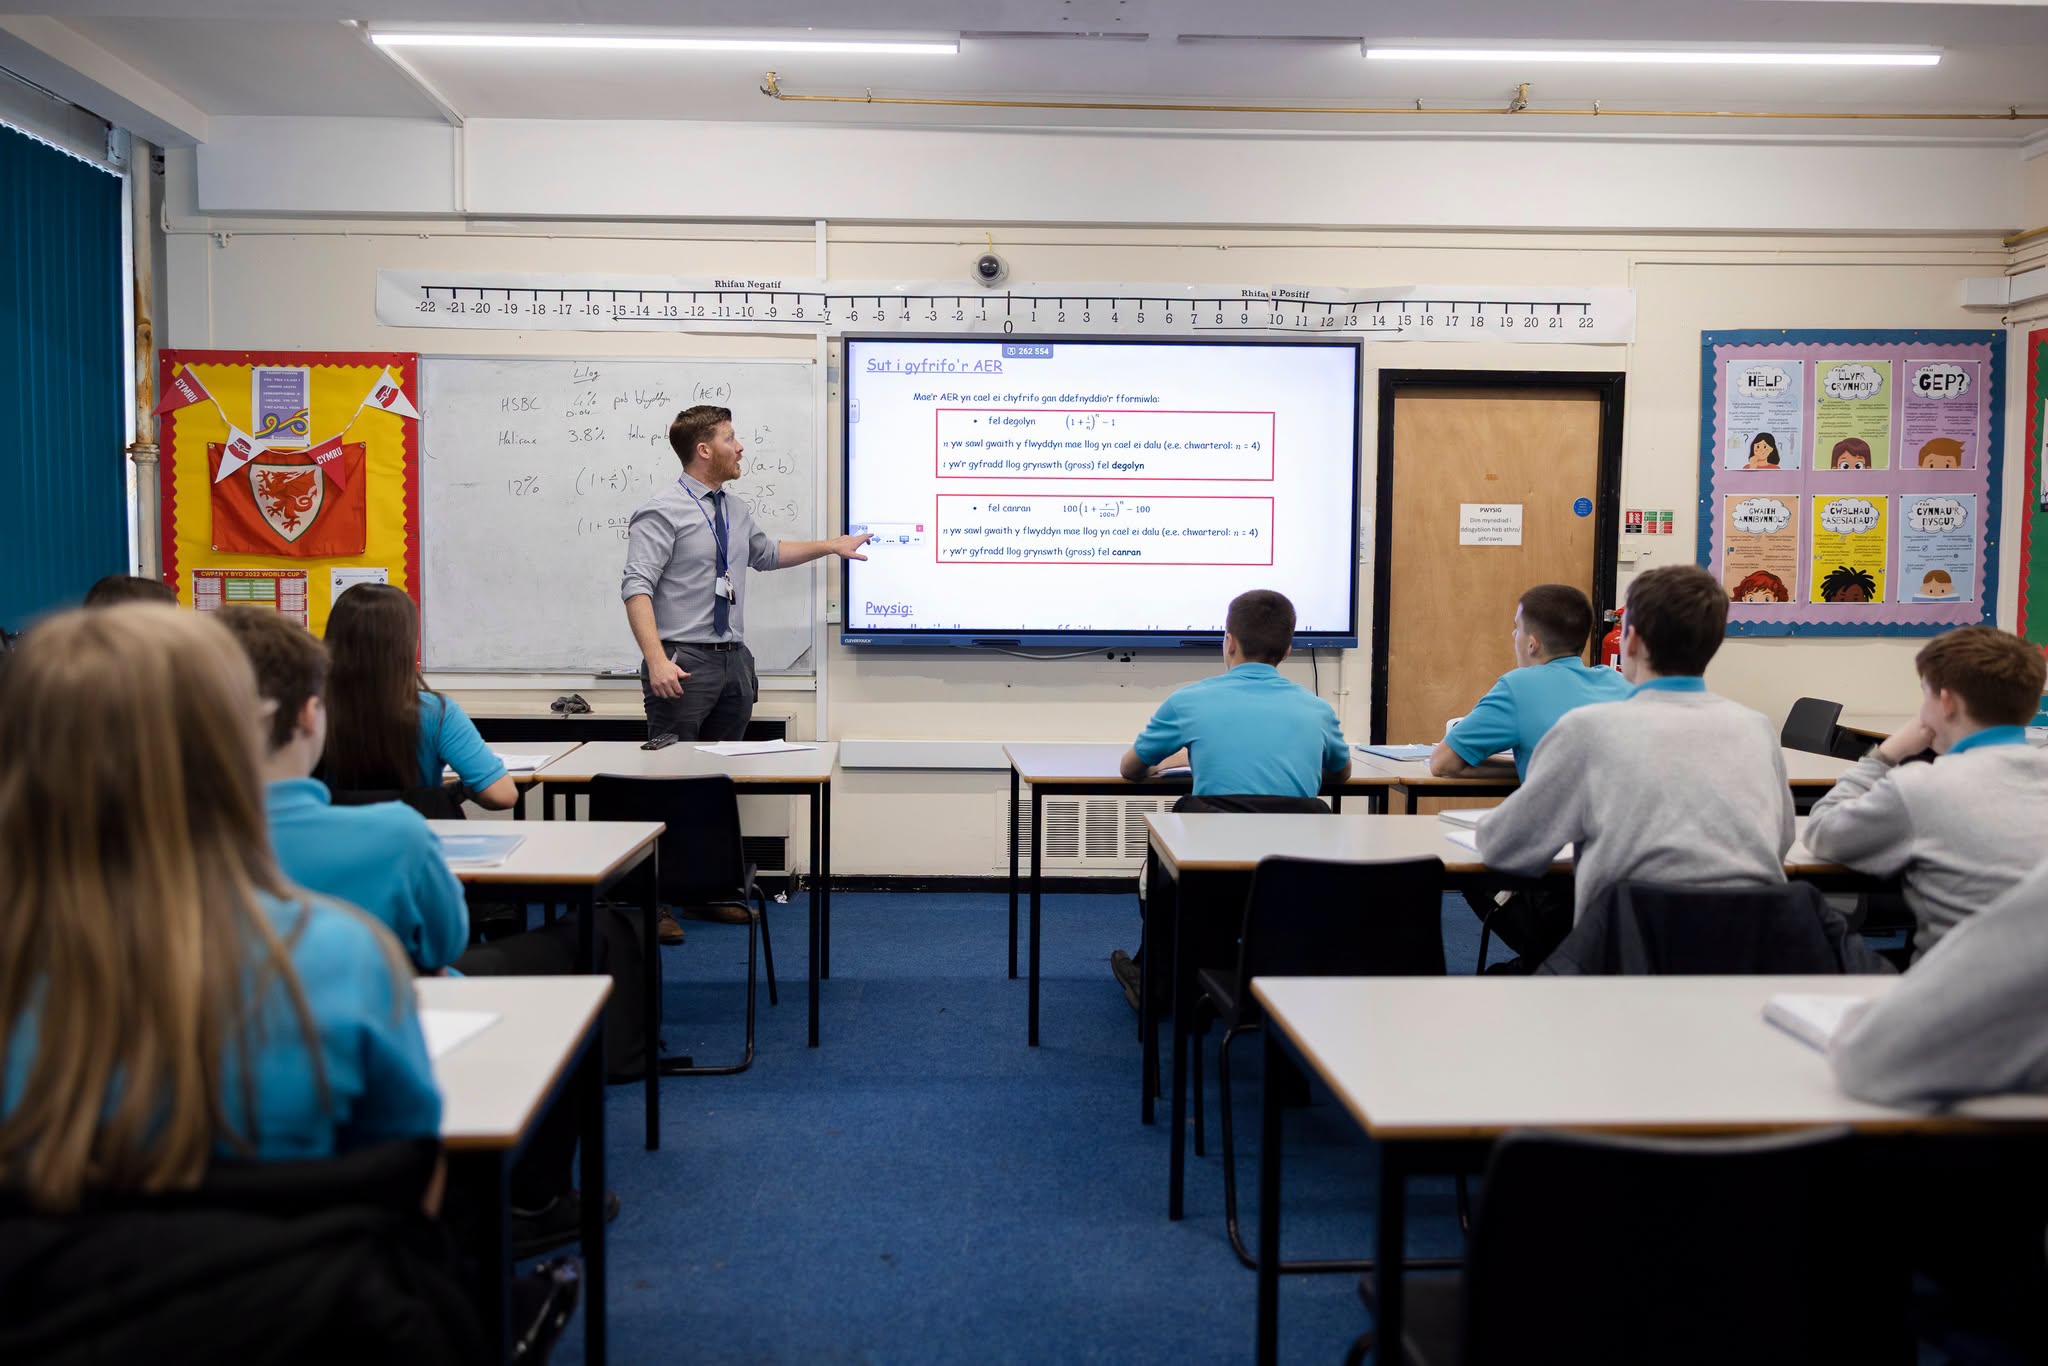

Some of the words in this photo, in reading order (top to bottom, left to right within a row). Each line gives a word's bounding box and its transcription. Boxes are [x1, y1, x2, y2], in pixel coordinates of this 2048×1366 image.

[714, 280, 746, 288] Rhifau
[747, 280, 781, 290] Negatif
[1279, 290, 1309, 298] Positif
[415, 302, 435, 312] -22
[447, 302, 465, 313] -21
[470, 303, 490, 313] -20
[497, 304, 518, 314] -19
[525, 304, 546, 315] -18
[553, 304, 572, 315] -17
[579, 304, 600, 315] -16
[606, 305, 626, 316] -15
[630, 305, 650, 316] -14
[657, 306, 677, 316] -13
[684, 306, 704, 317] -12
[712, 307, 730, 317] -11
[735, 307, 754, 317] -10
[765, 307, 777, 317] -9
[791, 308, 804, 318] -8
[818, 309, 831, 320] -7
[846, 310, 858, 322] -6
[872, 311, 885, 322] -5
[899, 311, 910, 322] -4
[925, 311, 937, 322] -3
[951, 311, 964, 322] -2
[976, 311, 987, 322] -1
[1004, 321, 1013, 334] 0
[1031, 312, 1036, 322] 1
[1058, 312, 1065, 322] 2
[1083, 312, 1090, 322] 3
[1111, 313, 1118, 323] 4
[1137, 313, 1144, 323] 5
[1166, 313, 1173, 323] 6
[1191, 313, 1198, 324] 7
[1216, 313, 1223, 324] 8
[1241, 313, 1248, 324] 9
[1269, 314, 1283, 325] 10
[1295, 315, 1308, 326] 11
[1320, 317, 1334, 327] 12
[1344, 315, 1357, 326] 13
[1372, 315, 1386, 326] 14
[1398, 315, 1411, 326] 15
[1420, 315, 1434, 326] 16
[1446, 315, 1459, 326] 17
[1470, 316, 1484, 327] 18
[1500, 317, 1514, 327] 19
[1524, 317, 1539, 328] 20
[1549, 317, 1563, 328] 21
[1578, 317, 1594, 328] 22
[867, 358, 892, 371] Sut
[896, 359, 900, 371] i
[904, 358, 969, 375] gyfrifo'r
[974, 360, 1003, 372] AER
[1748, 375, 1783, 387] HELP
[1919, 374, 1965, 390] GEP?
[175, 378, 198, 403] CYMRU
[913, 392, 938, 401] Mae'r
[940, 393, 958, 401] AER
[961, 395, 971, 403] yn
[973, 393, 990, 401] cael
[993, 394, 1000, 402] ei
[1003, 393, 1040, 404] chyfrifo
[1042, 395, 1056, 404] gan
[1059, 394, 1113, 405] ddefnyddio'r
[1116, 394, 1160, 403] fformiwla:
[501, 397, 542, 413] HSBC
[988, 417, 1000, 425] fel
[1003, 417, 1036, 427] degolyn
[951, 441, 963, 449] yw
[965, 439, 983, 447] sawl
[986, 439, 1014, 449] gwaith
[1015, 441, 1021, 449] y
[1024, 440, 1062, 450] flwyddyn
[1084, 440, 1099, 450] llog
[1101, 442, 1112, 450] yn
[1114, 440, 1131, 449] cael
[1134, 441, 1141, 449] ei
[1144, 441, 1161, 449] dalu
[1184, 441, 1233, 450] chwarterol:
[316, 446, 343, 465] CYMRU
[948, 461, 966, 469] yw'r
[968, 460, 1003, 470] gyfradd
[1006, 460, 1020, 470] llog
[1023, 460, 1062, 471] grynswth
[1064, 460, 1095, 471] (gross)
[1097, 460, 1110, 469] fel
[1112, 461, 1144, 471] degolyn
[988, 504, 1000, 512] fel
[950, 528, 962, 536] yw
[964, 526, 982, 534] sawl
[984, 527, 1012, 536] gwaith
[1015, 528, 1020, 536] y
[1023, 527, 1061, 537] flwyddyn
[1083, 527, 1098, 537] llog
[1112, 528, 1129, 536] cael
[1132, 528, 1139, 536] ei
[1142, 528, 1159, 536] dalu
[1182, 528, 1231, 536] chwarterol:
[950, 548, 967, 556] yw'r
[969, 547, 1004, 557] gyfradd
[1006, 547, 1021, 557] llog
[1024, 547, 1062, 558] grynswth
[1065, 547, 1095, 558] (gross)
[1098, 548, 1110, 556] fel
[1112, 548, 1141, 556] canran
[865, 601, 913, 617] Pwysig:
